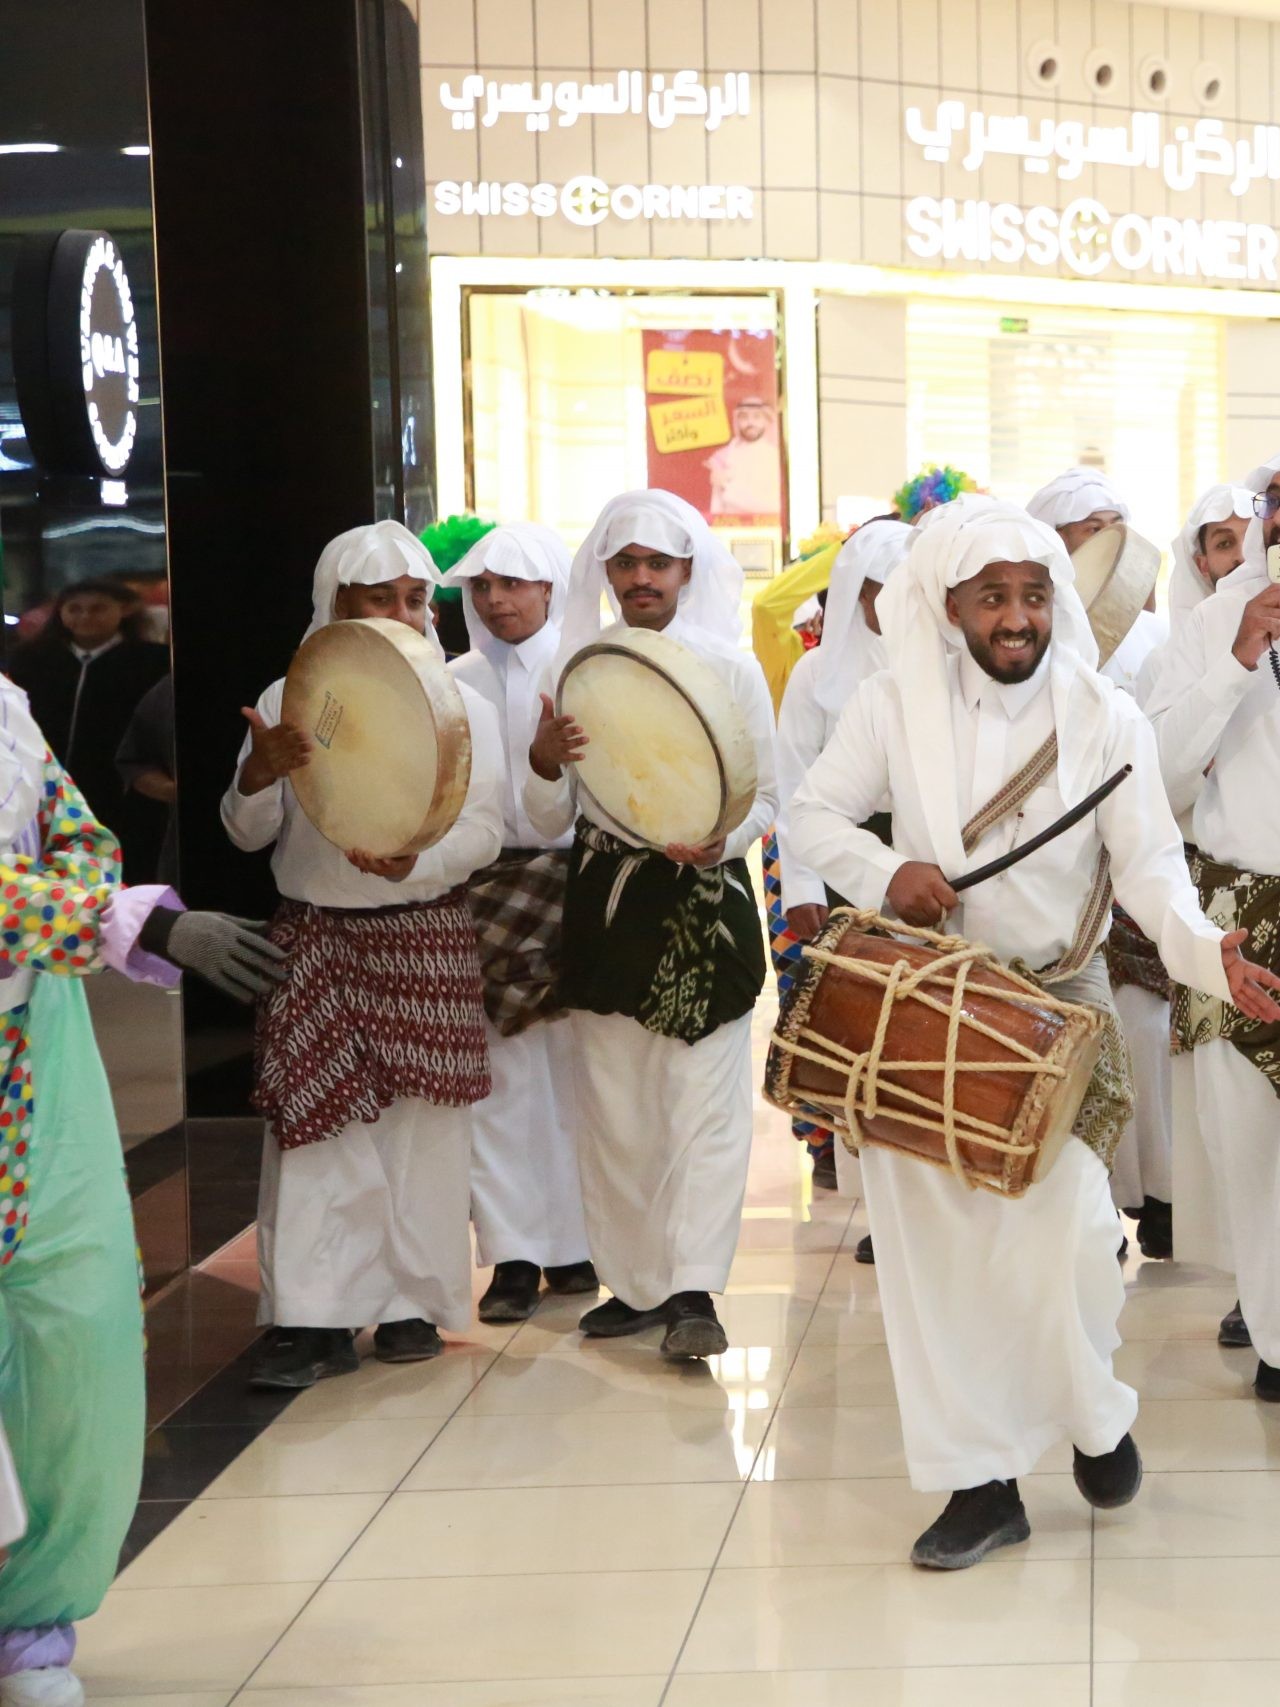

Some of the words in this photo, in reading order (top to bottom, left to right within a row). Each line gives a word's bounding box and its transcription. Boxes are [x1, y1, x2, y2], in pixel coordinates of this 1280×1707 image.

[440, 70, 642, 131] السويسري
[648, 70, 750, 131] الركن
[905, 100, 1159, 181] السويسري
[1164, 118, 1280, 197] الركن
[434, 181, 557, 216] SWISS
[905, 196, 1060, 267] SWISS
